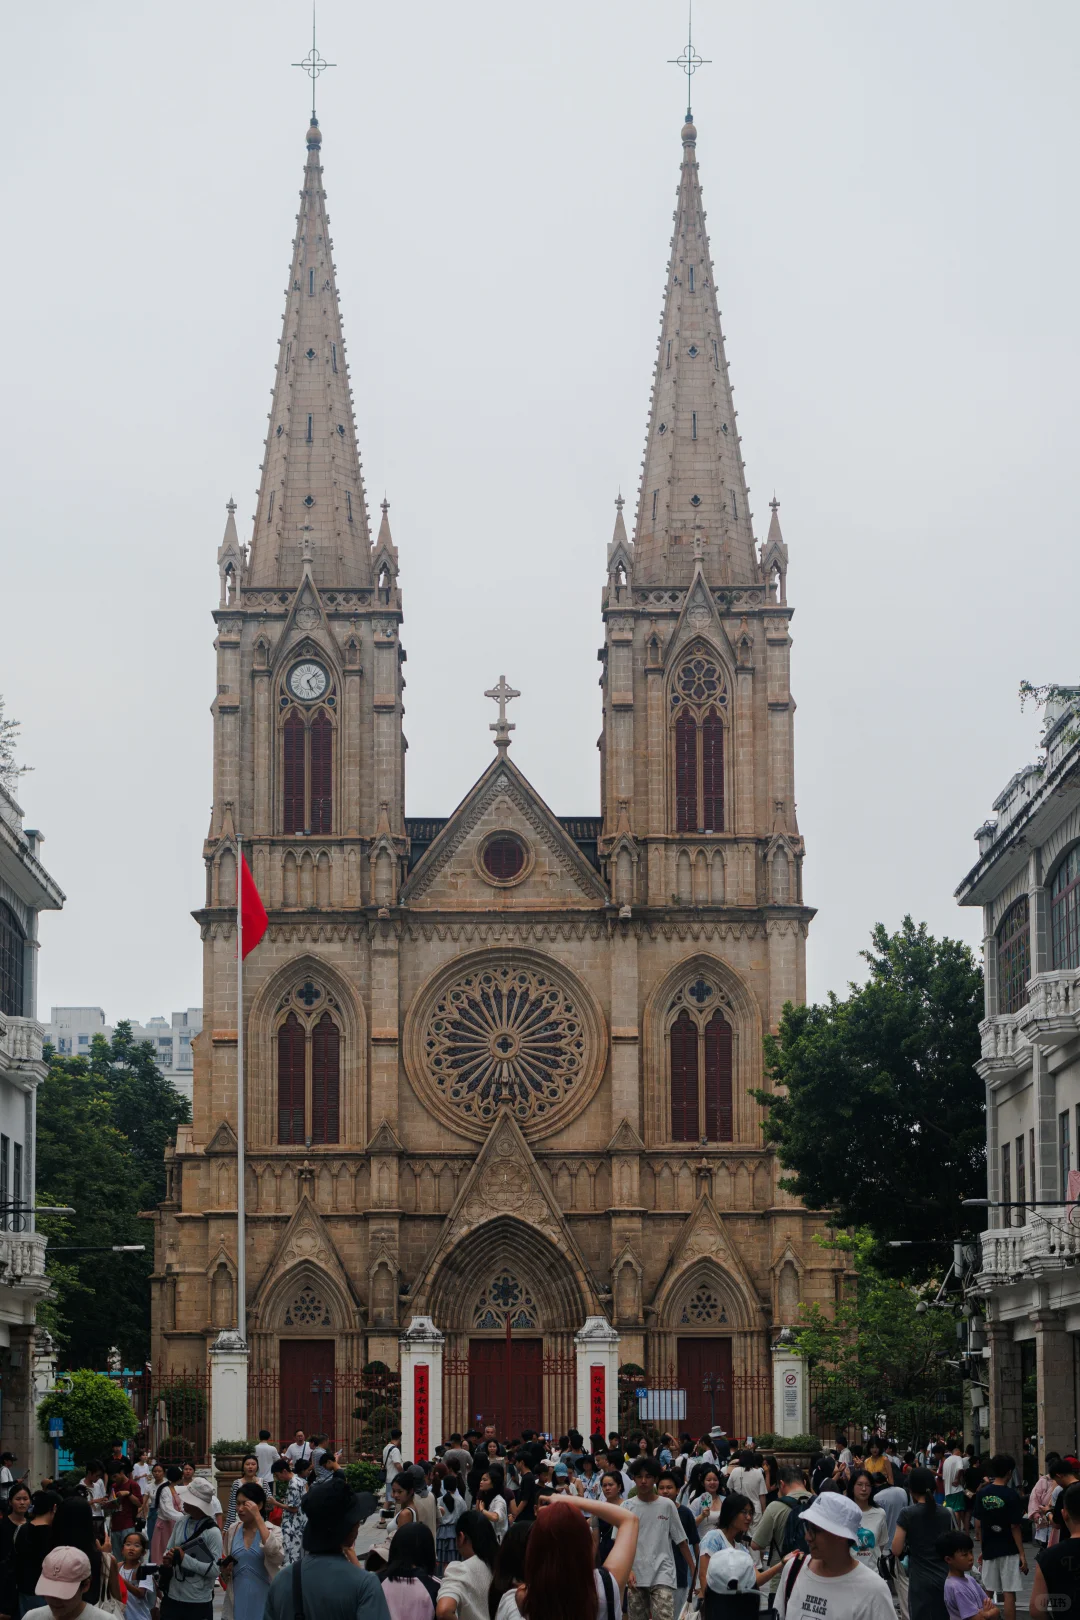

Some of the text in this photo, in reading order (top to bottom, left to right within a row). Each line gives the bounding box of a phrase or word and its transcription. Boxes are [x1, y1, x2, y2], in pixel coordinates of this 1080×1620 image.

[52, 1564, 62, 1576] P
[805, 1594, 827, 1607] HERE'S
[801, 1602, 827, 1615] MR. SACK
